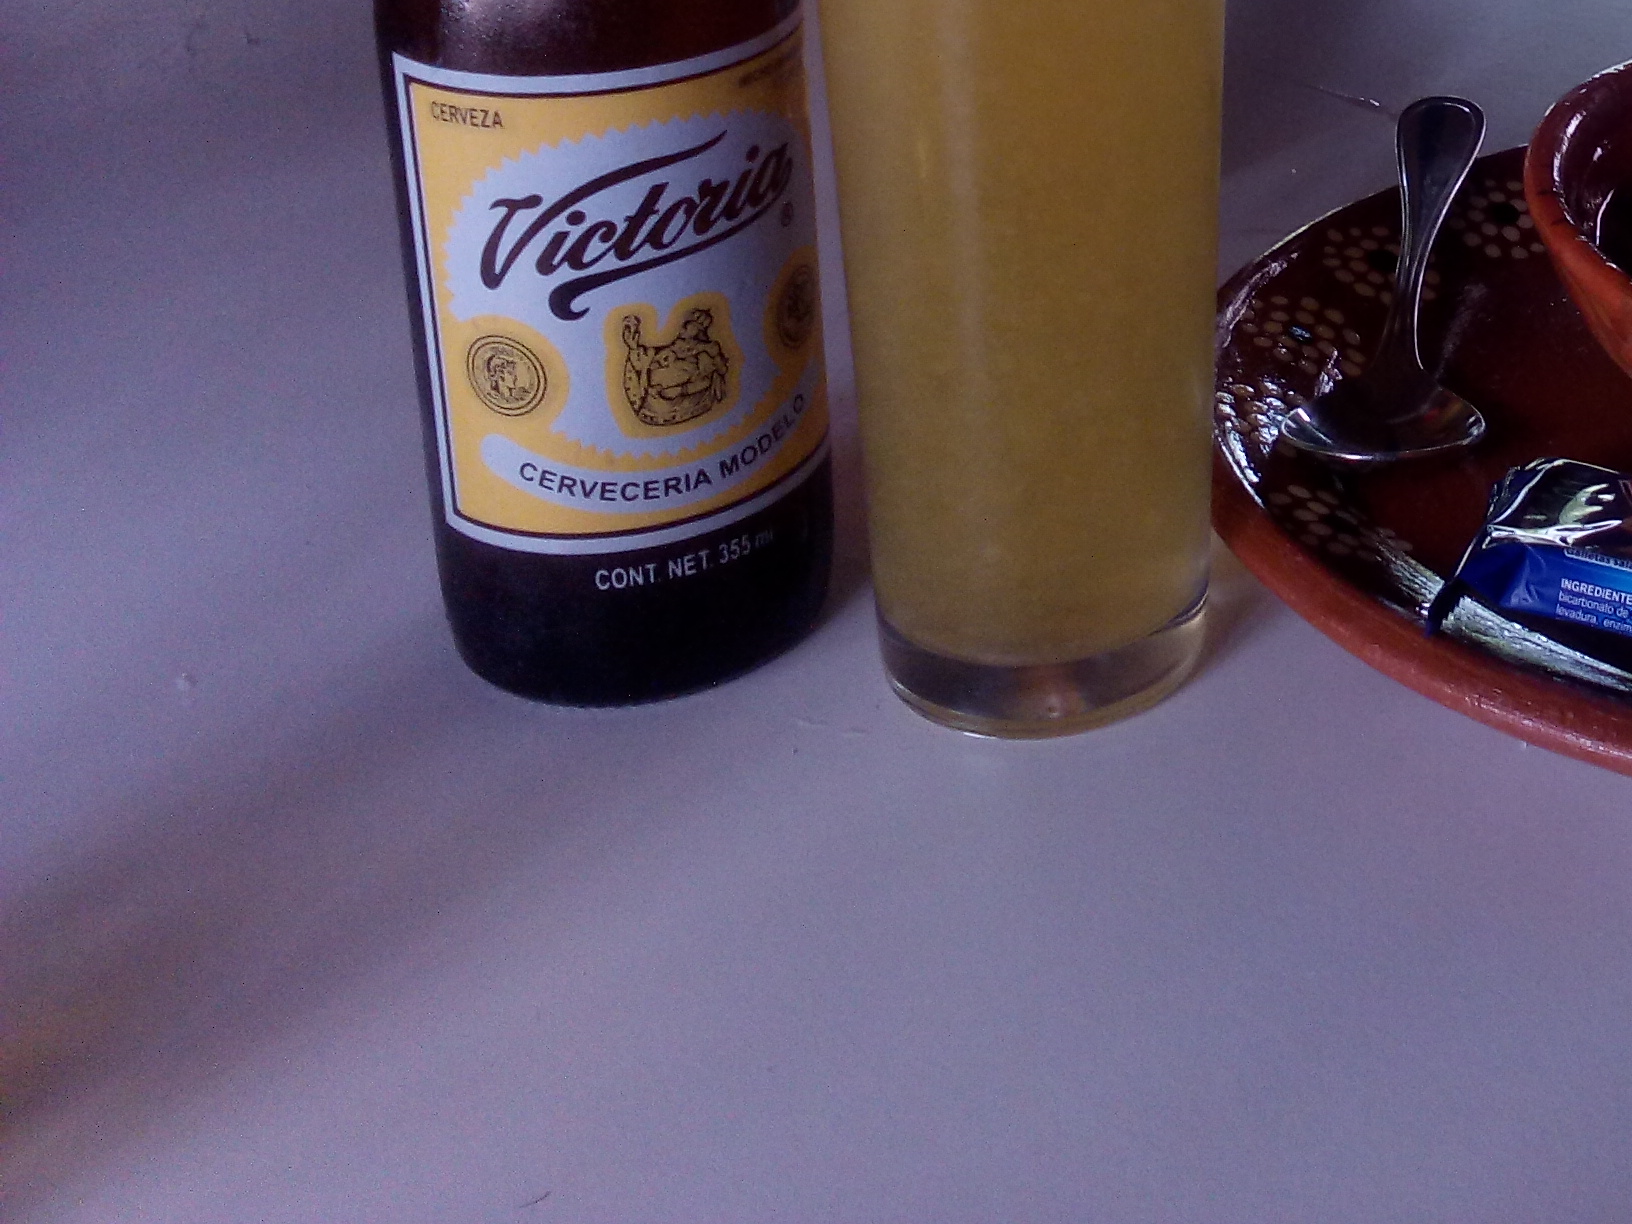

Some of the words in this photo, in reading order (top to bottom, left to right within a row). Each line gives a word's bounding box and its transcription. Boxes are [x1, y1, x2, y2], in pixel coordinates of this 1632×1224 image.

[431, 101, 504, 127] CERVEZA
[480, 130, 794, 321] Victoria
[519, 462, 713, 502] CERVECERIA
[718, 393, 805, 479] MODELO
[718, 534, 751, 564] 355
[1558, 590, 1615, 615] bicarbonato
[1616, 605, 1630, 618] de
